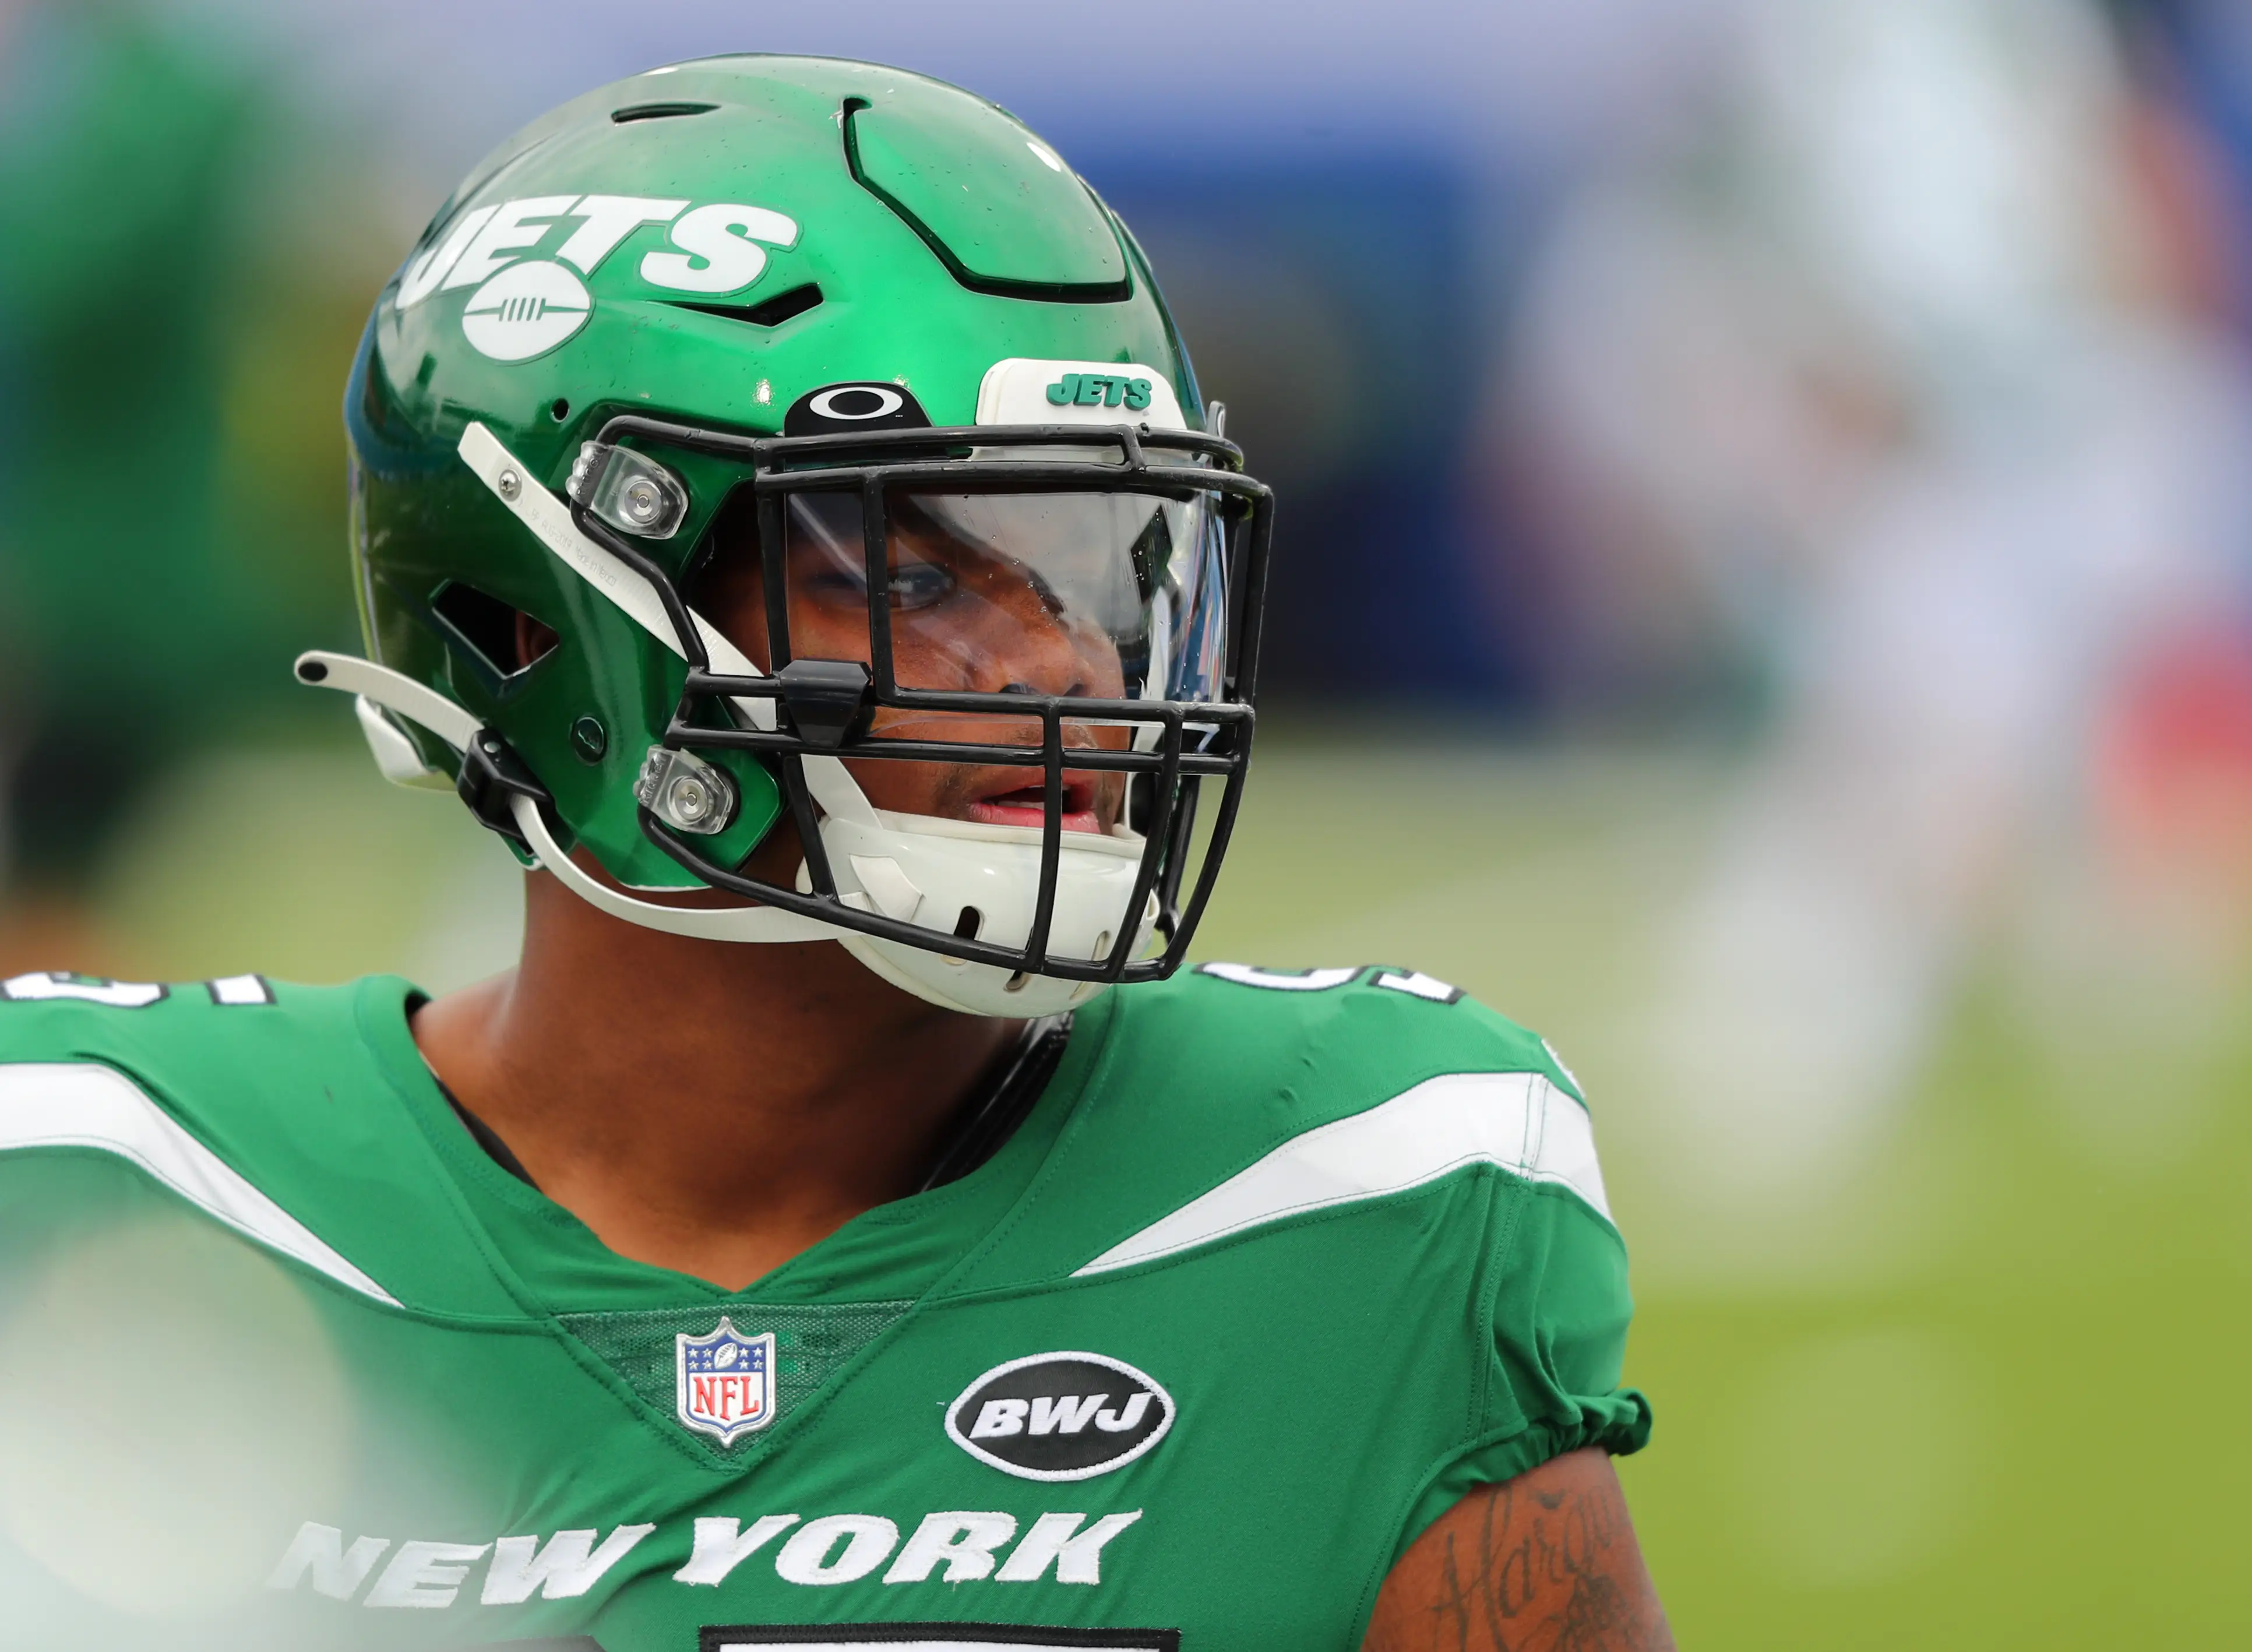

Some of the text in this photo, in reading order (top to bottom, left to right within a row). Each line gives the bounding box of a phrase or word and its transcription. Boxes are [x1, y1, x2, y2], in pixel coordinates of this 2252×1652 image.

[395, 195, 798, 309] JETS
[1046, 373, 1152, 411] JETS
[692, 1375, 760, 1420] NFL
[968, 1392, 1151, 1439] BWJ
[264, 1509, 1143, 1608] NEW YORK
